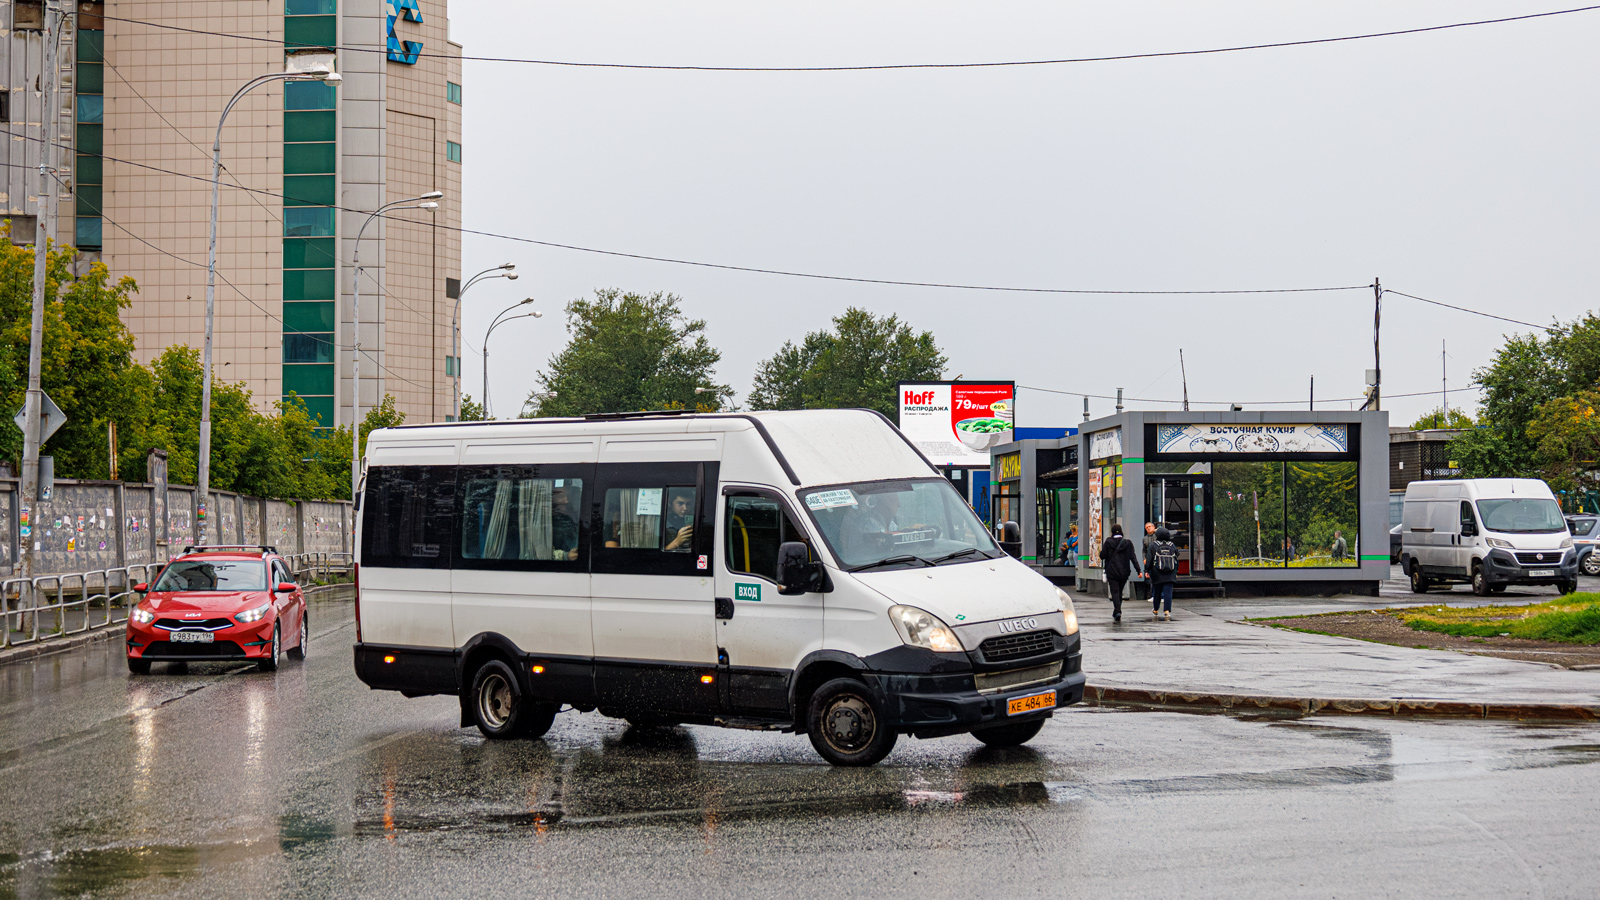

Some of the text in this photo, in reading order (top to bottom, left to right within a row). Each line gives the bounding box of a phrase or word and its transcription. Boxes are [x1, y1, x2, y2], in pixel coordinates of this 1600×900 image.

[904, 390, 935, 405] Hoff
[1210, 426, 1296, 434] ВОСТОЧНАЯ КУХНЯ
[901, 532, 926, 542] IVECO
[738, 586, 758, 600] ВХОД
[998, 618, 1038, 633] IVECO
[1011, 693, 1053, 712] КЕ 484 66
